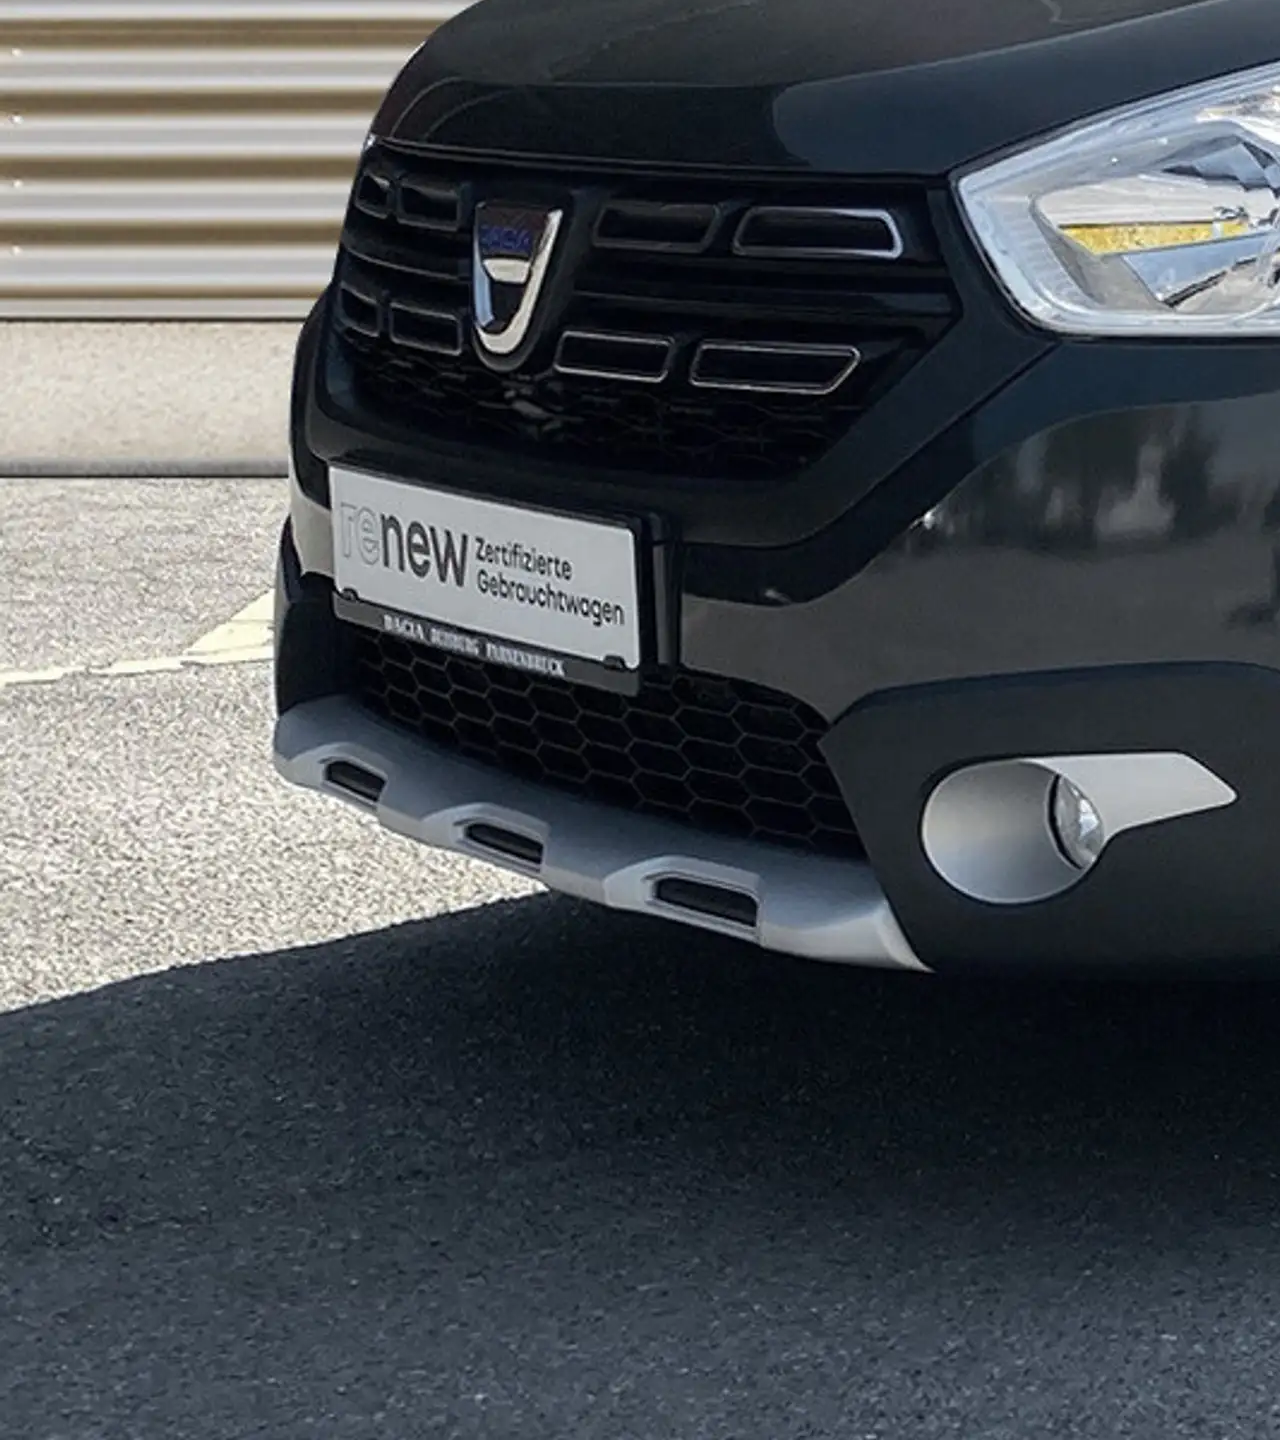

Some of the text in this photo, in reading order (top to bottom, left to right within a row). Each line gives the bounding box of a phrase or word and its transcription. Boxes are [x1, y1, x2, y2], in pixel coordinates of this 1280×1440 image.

[340, 501, 469, 588] renew
[475, 536, 572, 580] Zertifizierte
[477, 568, 625, 627] Gebrauchtwagen
